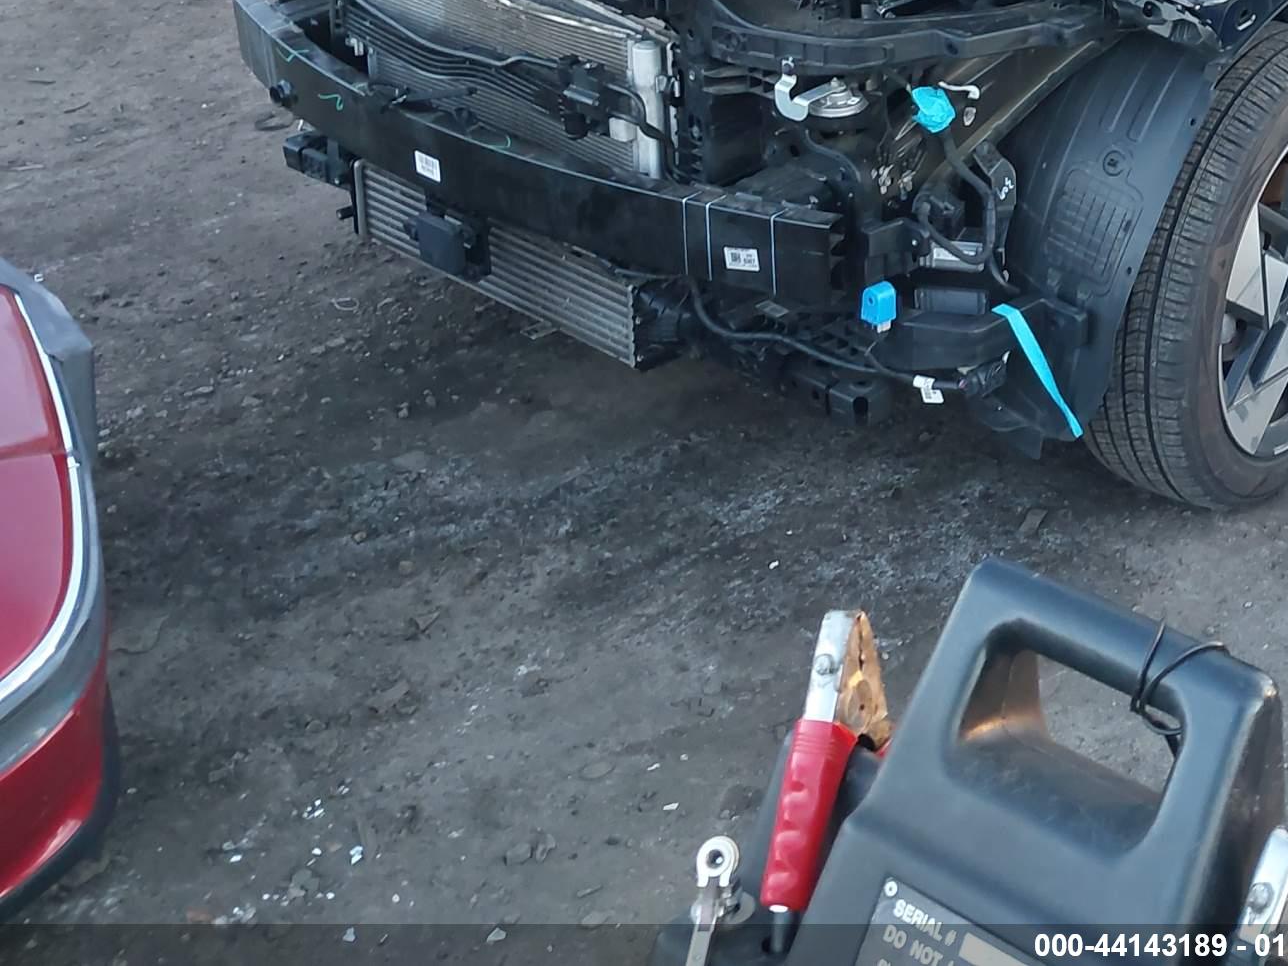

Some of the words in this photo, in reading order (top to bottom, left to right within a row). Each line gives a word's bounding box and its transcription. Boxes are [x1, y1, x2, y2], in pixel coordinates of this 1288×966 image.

[892, 898, 946, 942] SERIAL
[882, 923, 908, 950] DO
[909, 939, 944, 966] NOT
